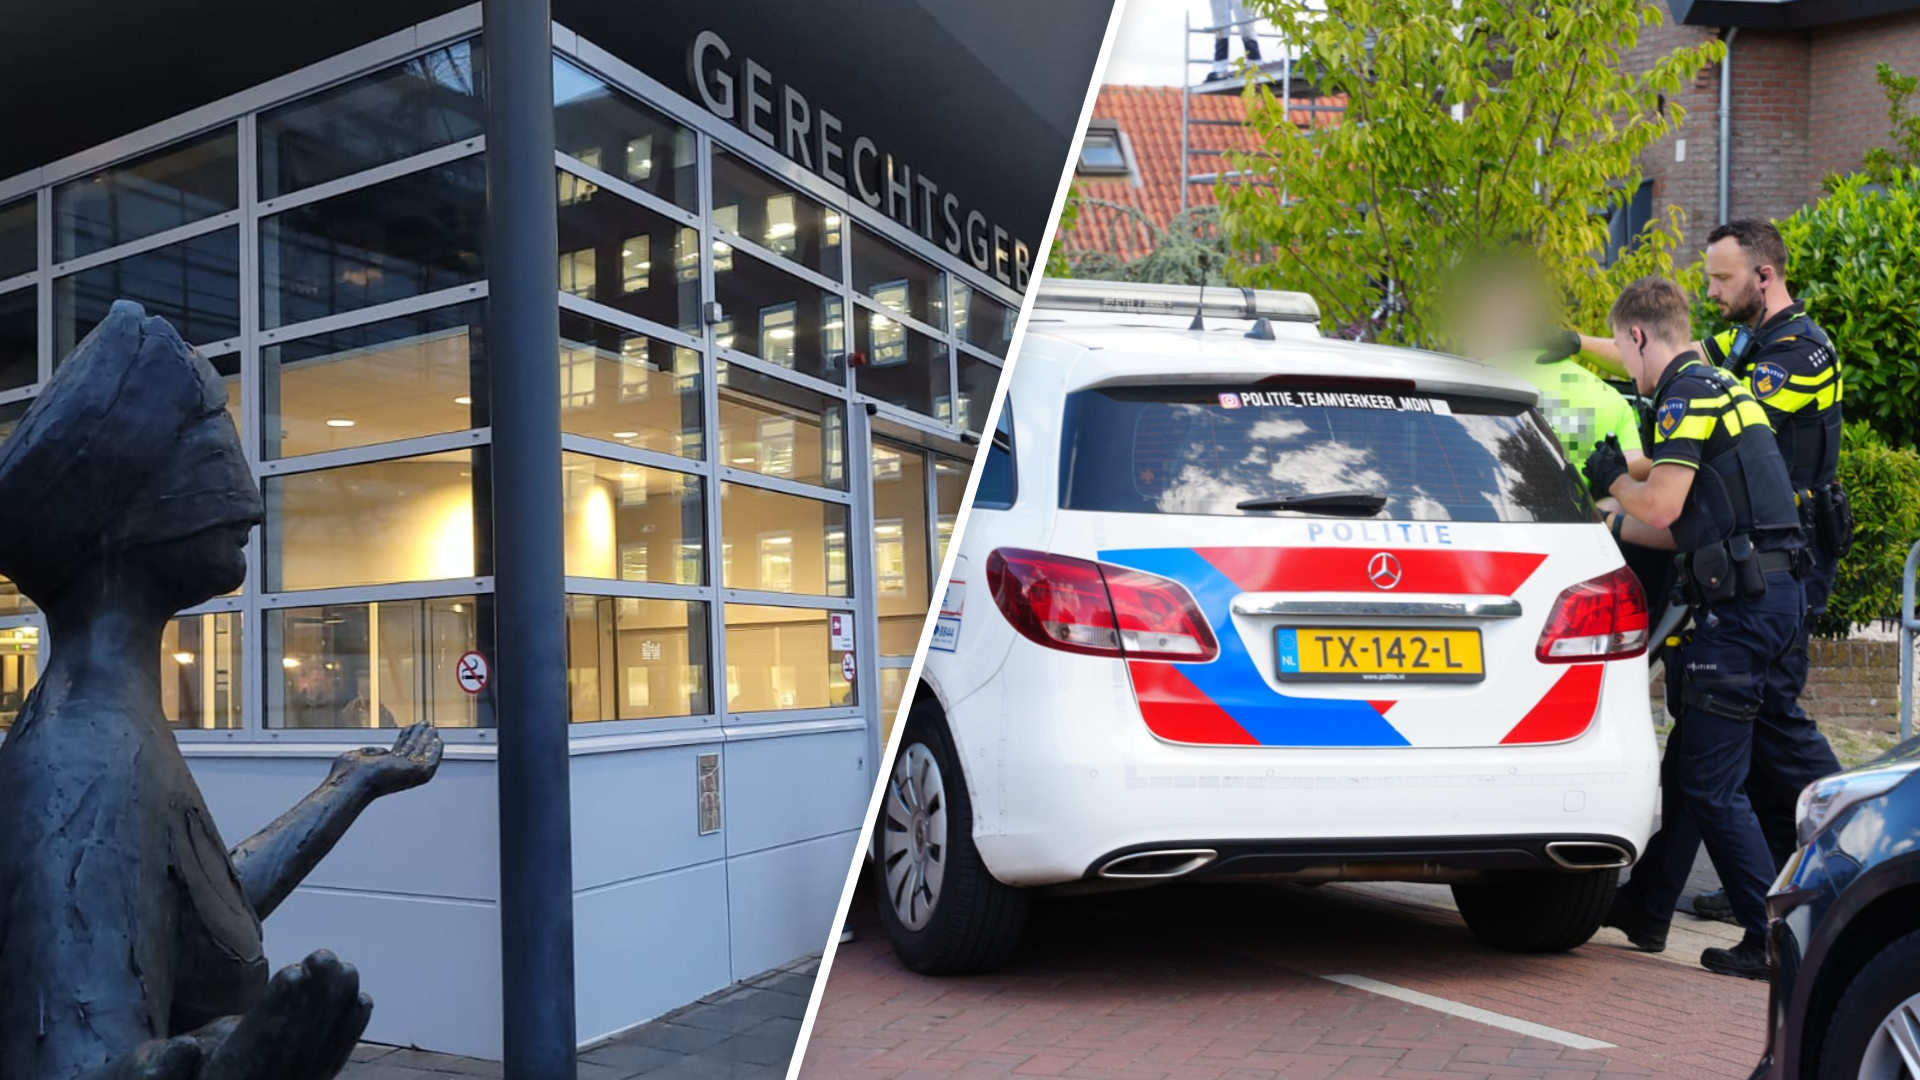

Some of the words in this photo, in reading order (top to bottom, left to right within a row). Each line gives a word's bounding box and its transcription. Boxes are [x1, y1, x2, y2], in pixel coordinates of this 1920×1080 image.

[692, 30, 1030, 292] GERECHTSGEB
[1240, 392, 1431, 412] POLITIE_TEAMVERKEER_MDN
[1307, 523, 1452, 544] POLITIE
[1282, 655, 1297, 667] NL
[1315, 636, 1462, 667] TX-142-L
[1362, 673, 1406, 681] www.politie.nl
